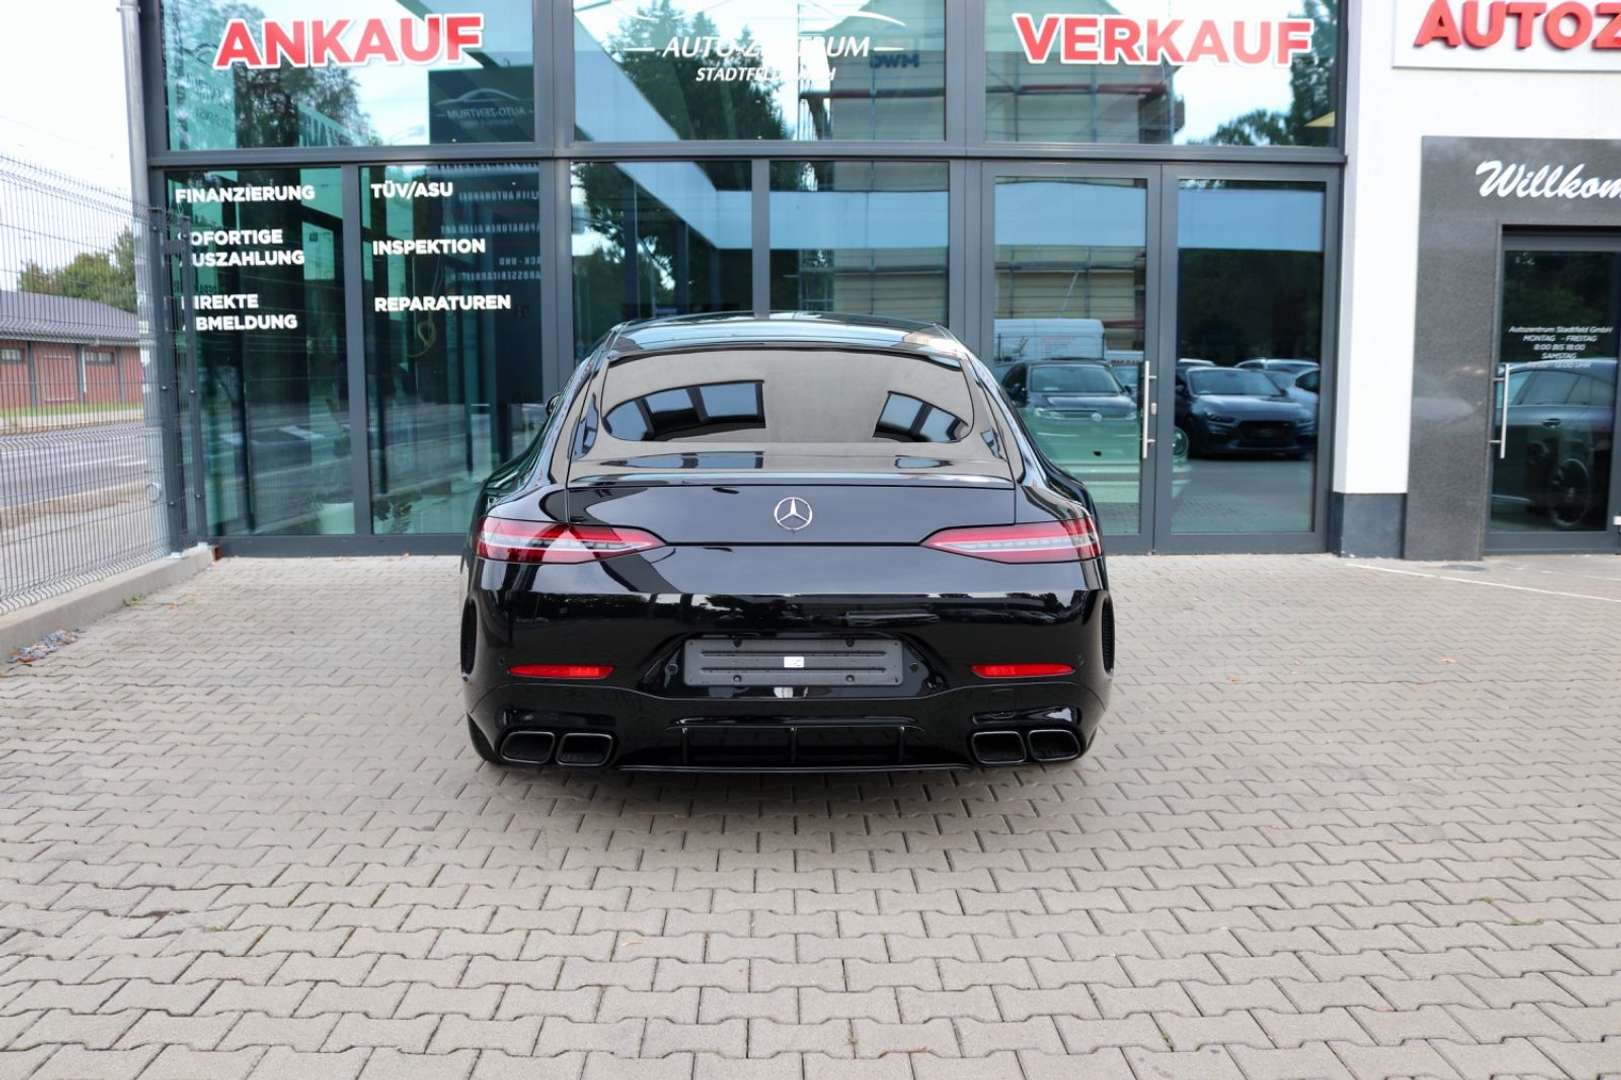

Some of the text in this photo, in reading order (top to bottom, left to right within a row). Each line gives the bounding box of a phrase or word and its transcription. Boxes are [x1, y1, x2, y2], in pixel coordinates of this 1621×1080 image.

[1413, 0, 1621, 50] AUTOZ
[213, 14, 484, 69] ANKAUF
[662, 36, 870, 58] AUTO-ZUM
[1013, 14, 1314, 67] VERKAUF
[175, 185, 316, 203] FINANZIERUNG
[371, 180, 454, 200] TÜV/ASU
[178, 229, 283, 246] OFORTIGE
[372, 238, 486, 256] INSPEKTION
[179, 250, 304, 267] USZAHLUNG
[181, 294, 259, 310] IREKTE
[374, 294, 512, 312] REPARATUREN
[182, 314, 298, 331] BMELDUNG
